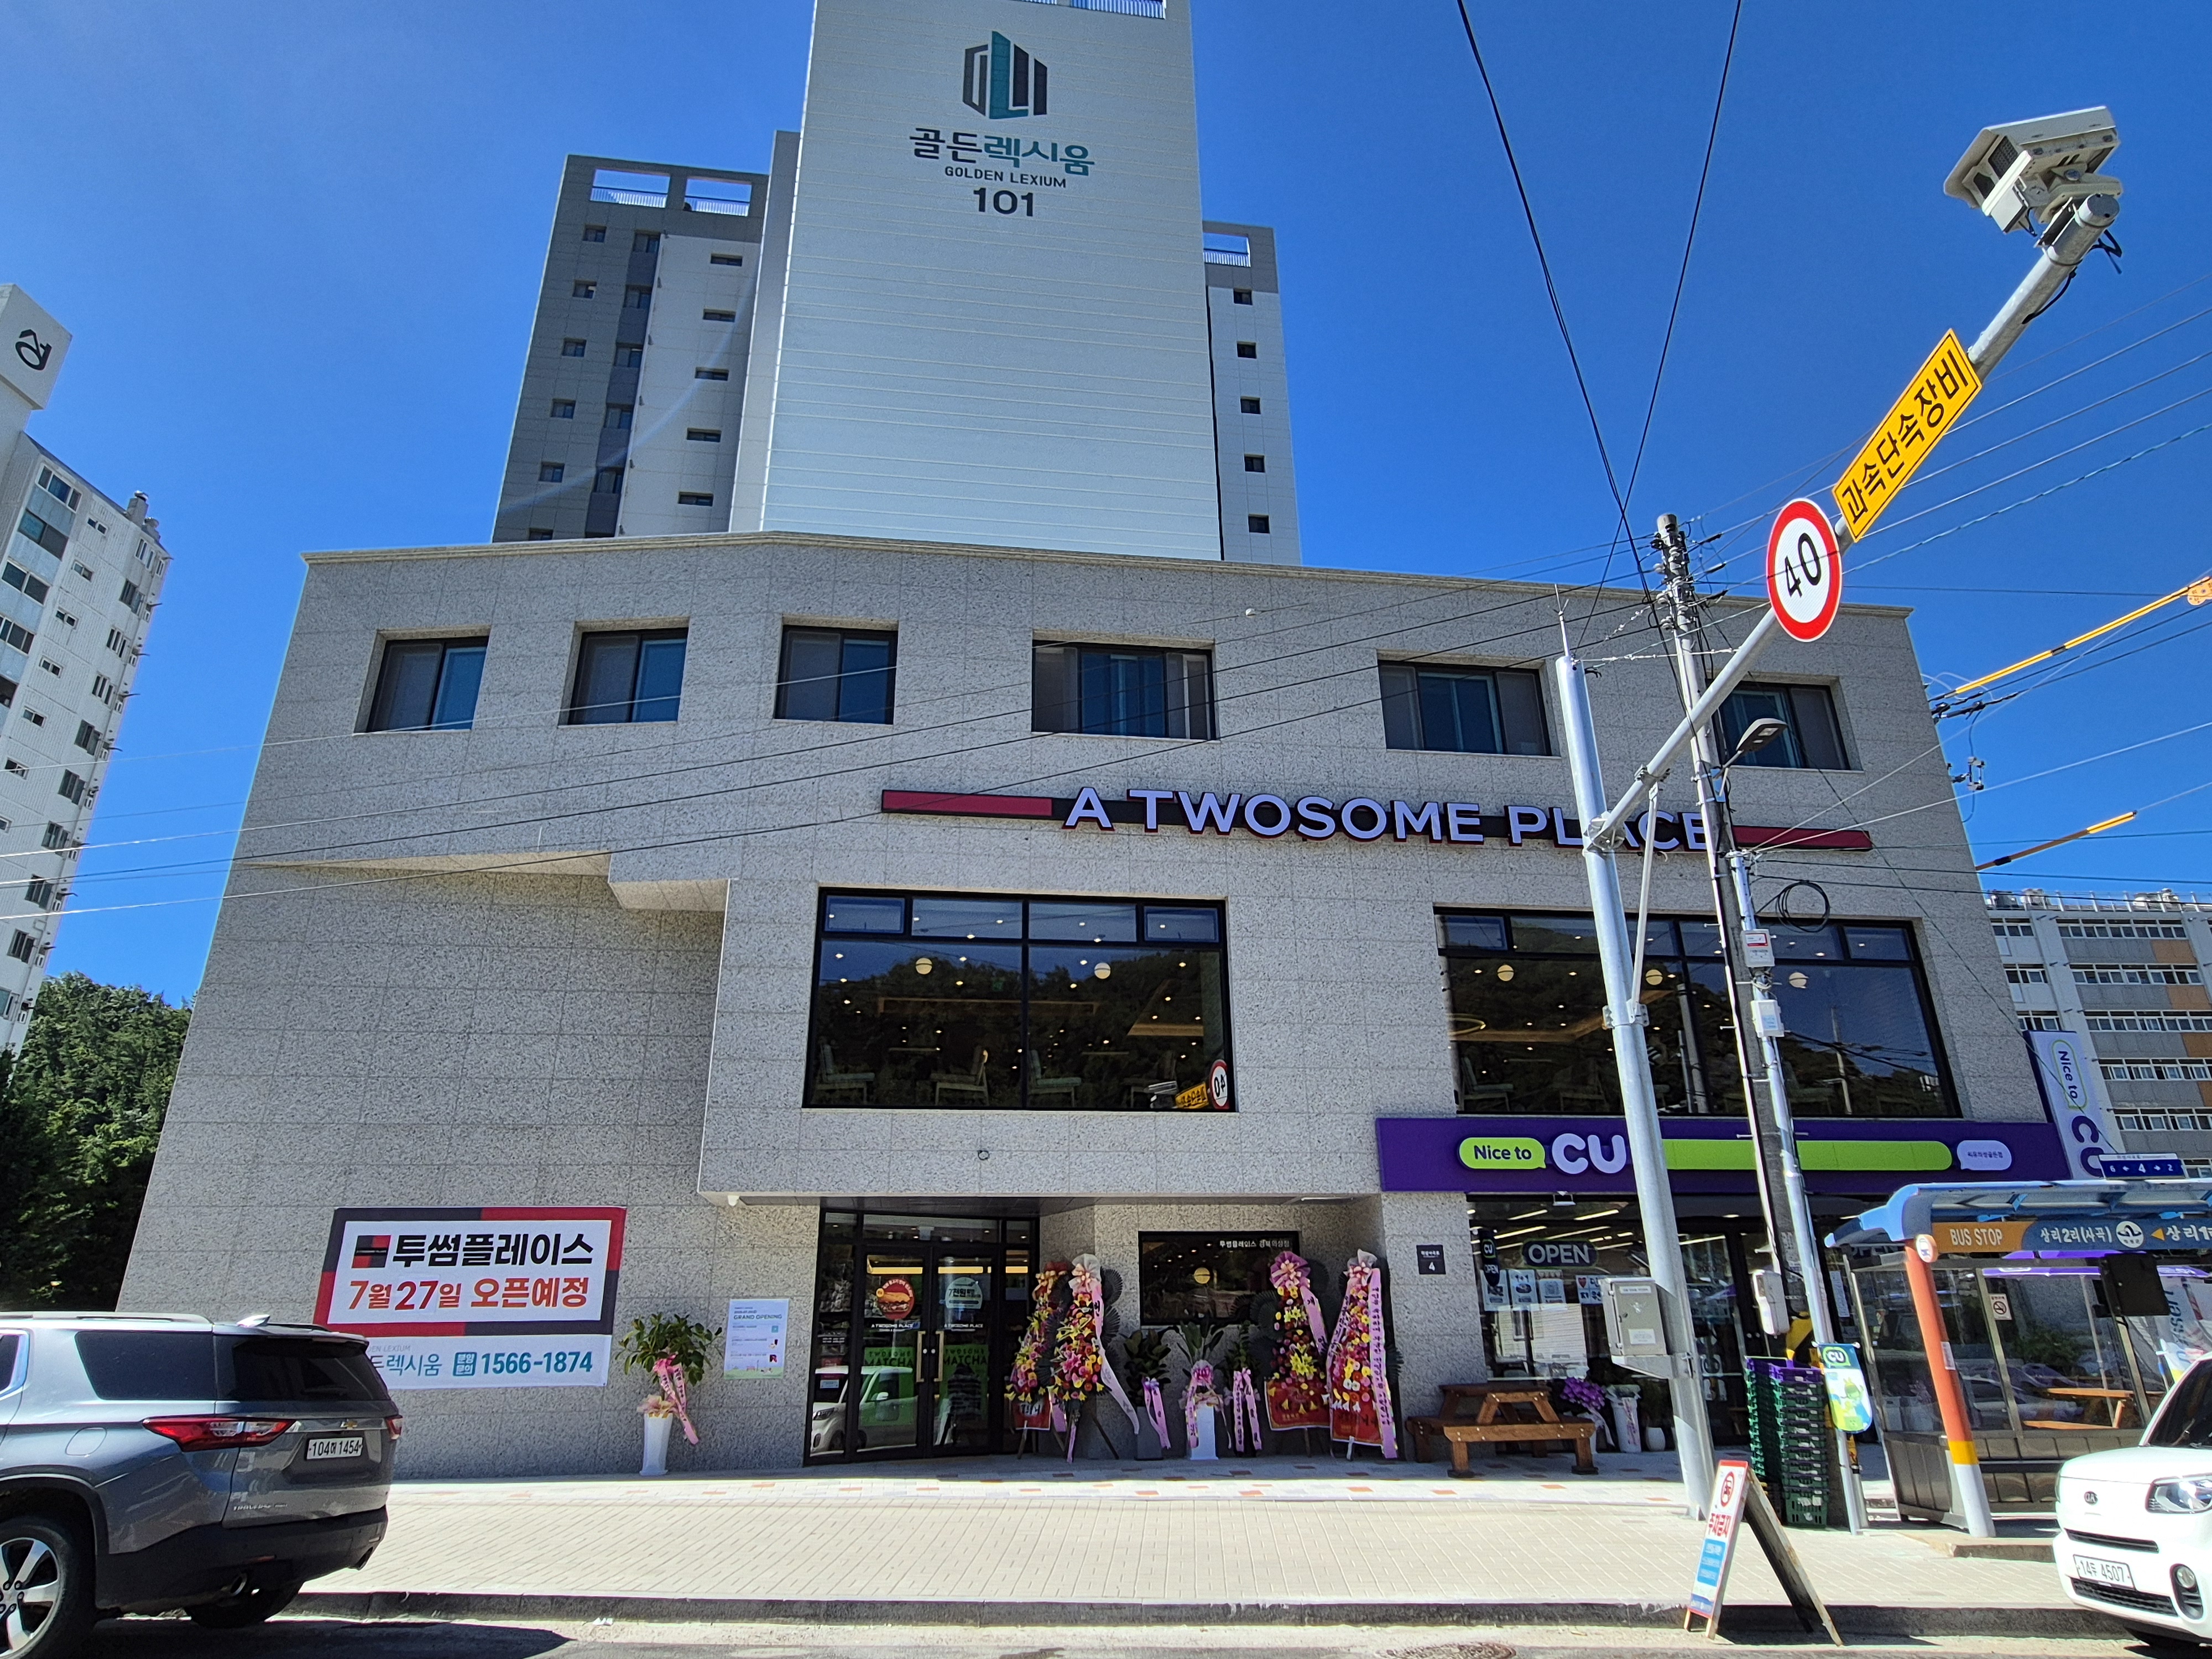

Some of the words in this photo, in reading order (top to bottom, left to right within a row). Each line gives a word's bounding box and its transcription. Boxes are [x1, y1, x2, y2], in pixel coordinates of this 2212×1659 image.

[910, 128, 1095, 176] 골든렉시움
[945, 166, 1004, 181] GOLDEN
[1010, 171, 1066, 188] LEXIUM
[973, 187, 1034, 217] 101
[1841, 349, 1969, 524] 과속단속장비
[1784, 533, 1822, 598] 40
[1063, 787, 1114, 830] A
[1126, 789, 1485, 844] TWOSOME
[2058, 1050, 2073, 1082] Nice
[2068, 1085, 2078, 1099] to
[1474, 1145, 1511, 1160] Nice
[1514, 1146, 1532, 1160] to
[1552, 1133, 1627, 1175] CU
[2072, 1115, 2104, 1177] CU
[2138, 1163, 2146, 1173] 4
[1950, 1228, 1973, 1246] BUS
[1975, 1228, 2003, 1246] STOP
[2040, 1226, 2113, 1244] 상리2리(사곡)
[393, 1234, 594, 1267] 투썸플레이스
[1528, 1244, 1590, 1264] OPEN
[1428, 1261, 1435, 1271] 4
[471, 1277, 589, 1308] 오픈예정
[481, 1351, 593, 1374] 1566-1874
[1827, 1351, 1845, 1363] CU
